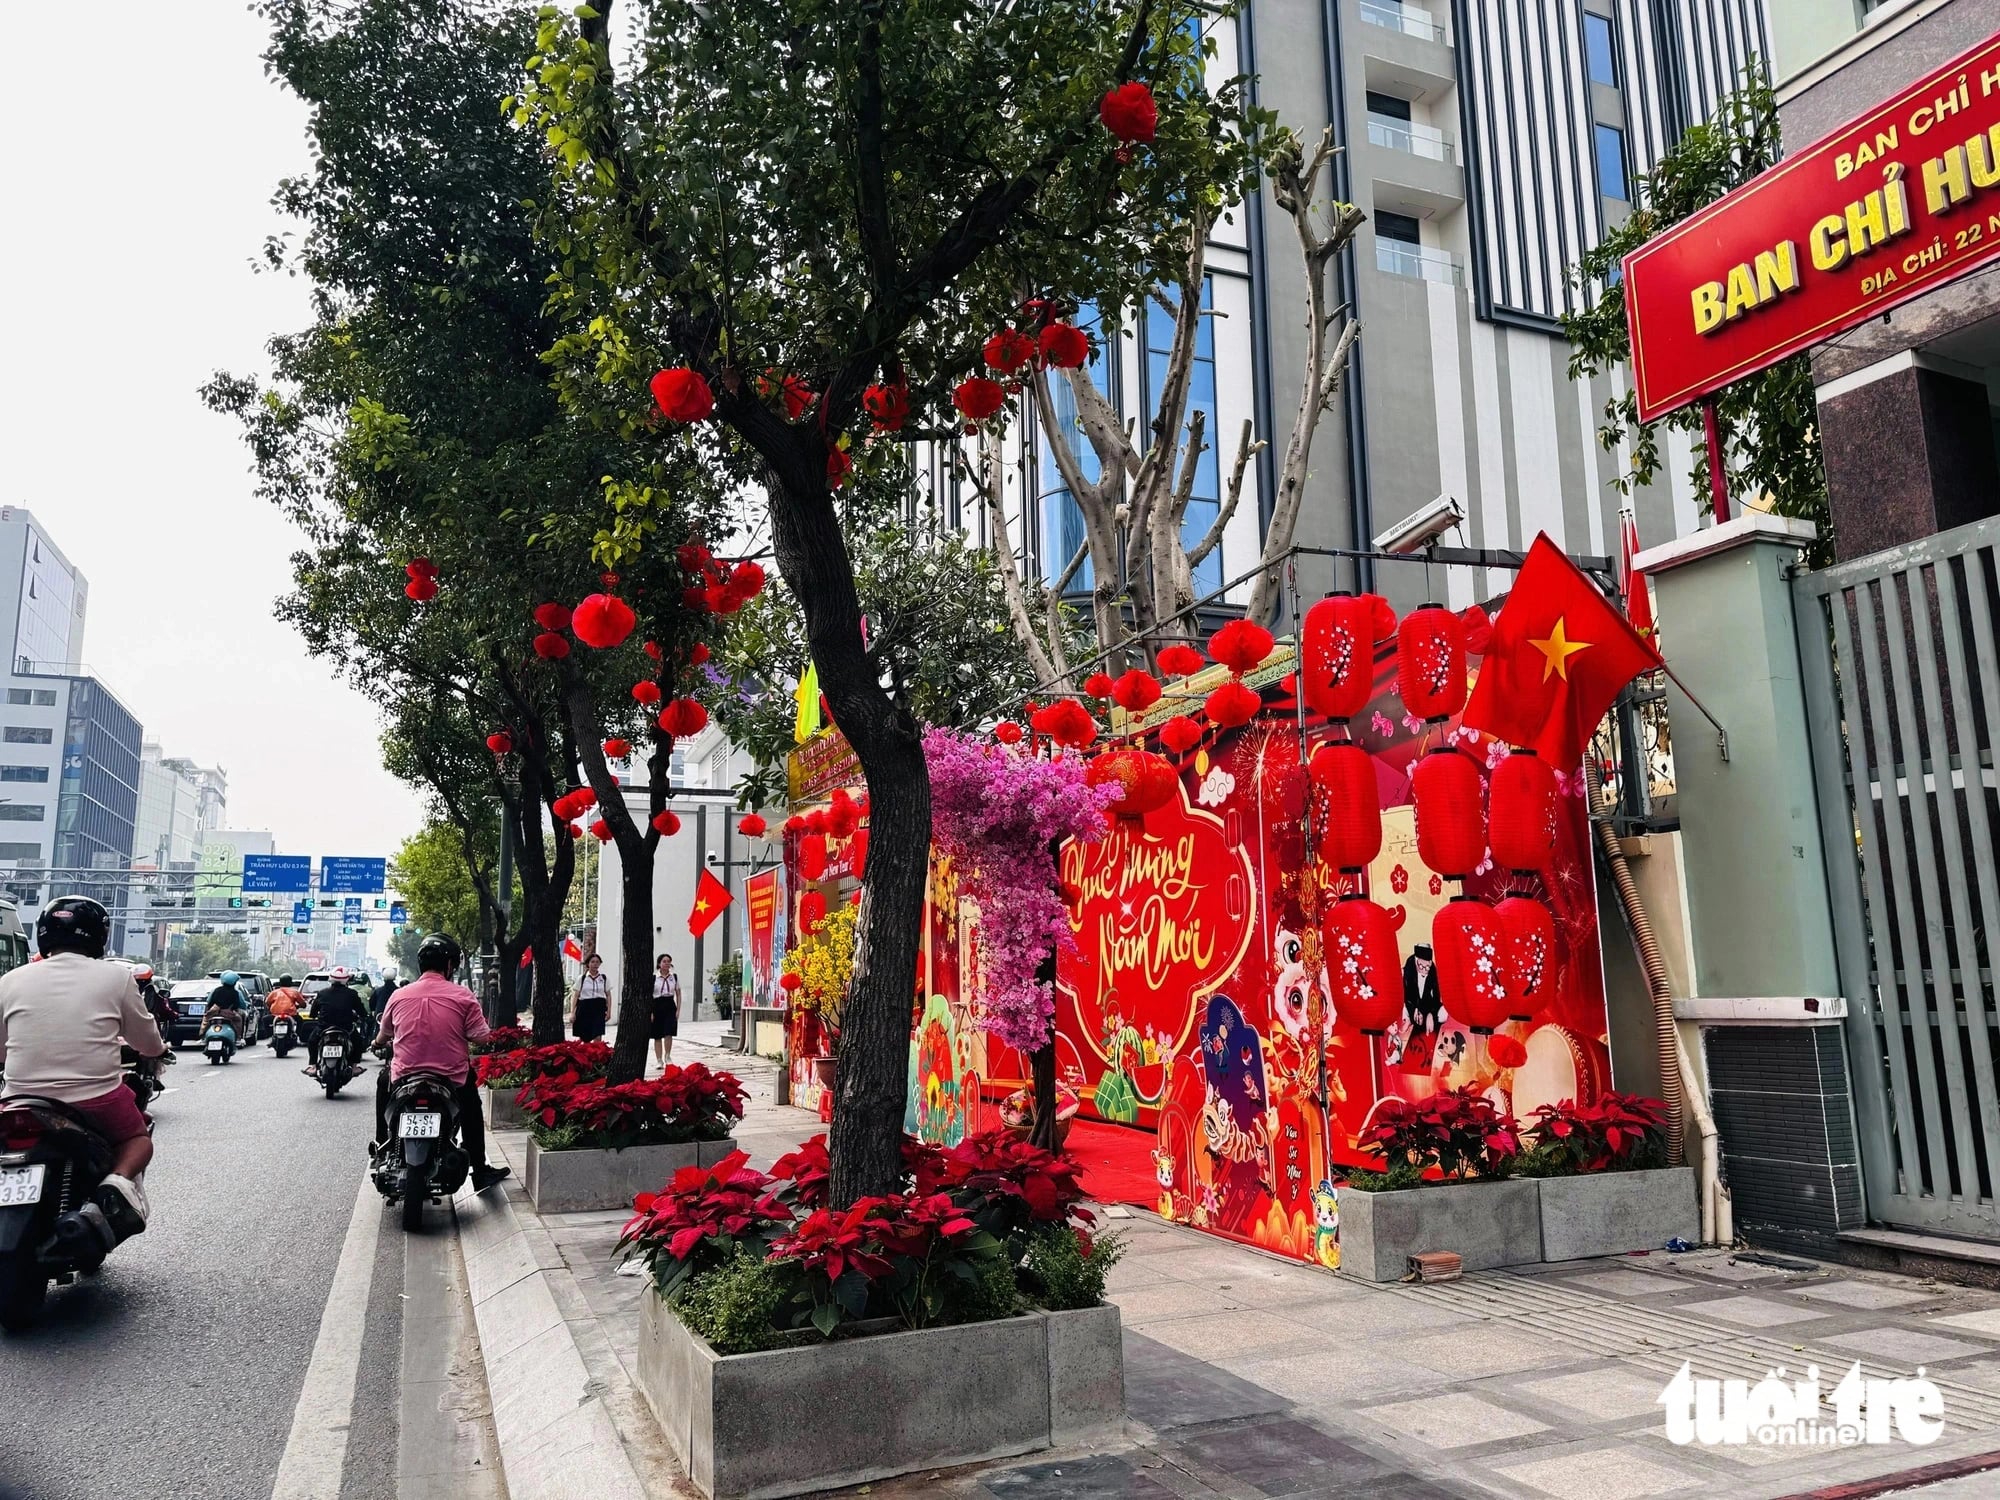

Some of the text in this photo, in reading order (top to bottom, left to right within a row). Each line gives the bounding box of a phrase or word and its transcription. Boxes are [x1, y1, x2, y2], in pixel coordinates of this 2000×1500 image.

[1834, 124, 1899, 181] BAN
[1908, 73, 1970, 136] CHỈ
[1690, 240, 1799, 335] BAN
[1810, 161, 1911, 271] CHỈ
[1861, 266, 1898, 296] ĐỊA
[1902, 235, 1949, 274] CHỈ:
[1954, 223, 1983, 250] 22
